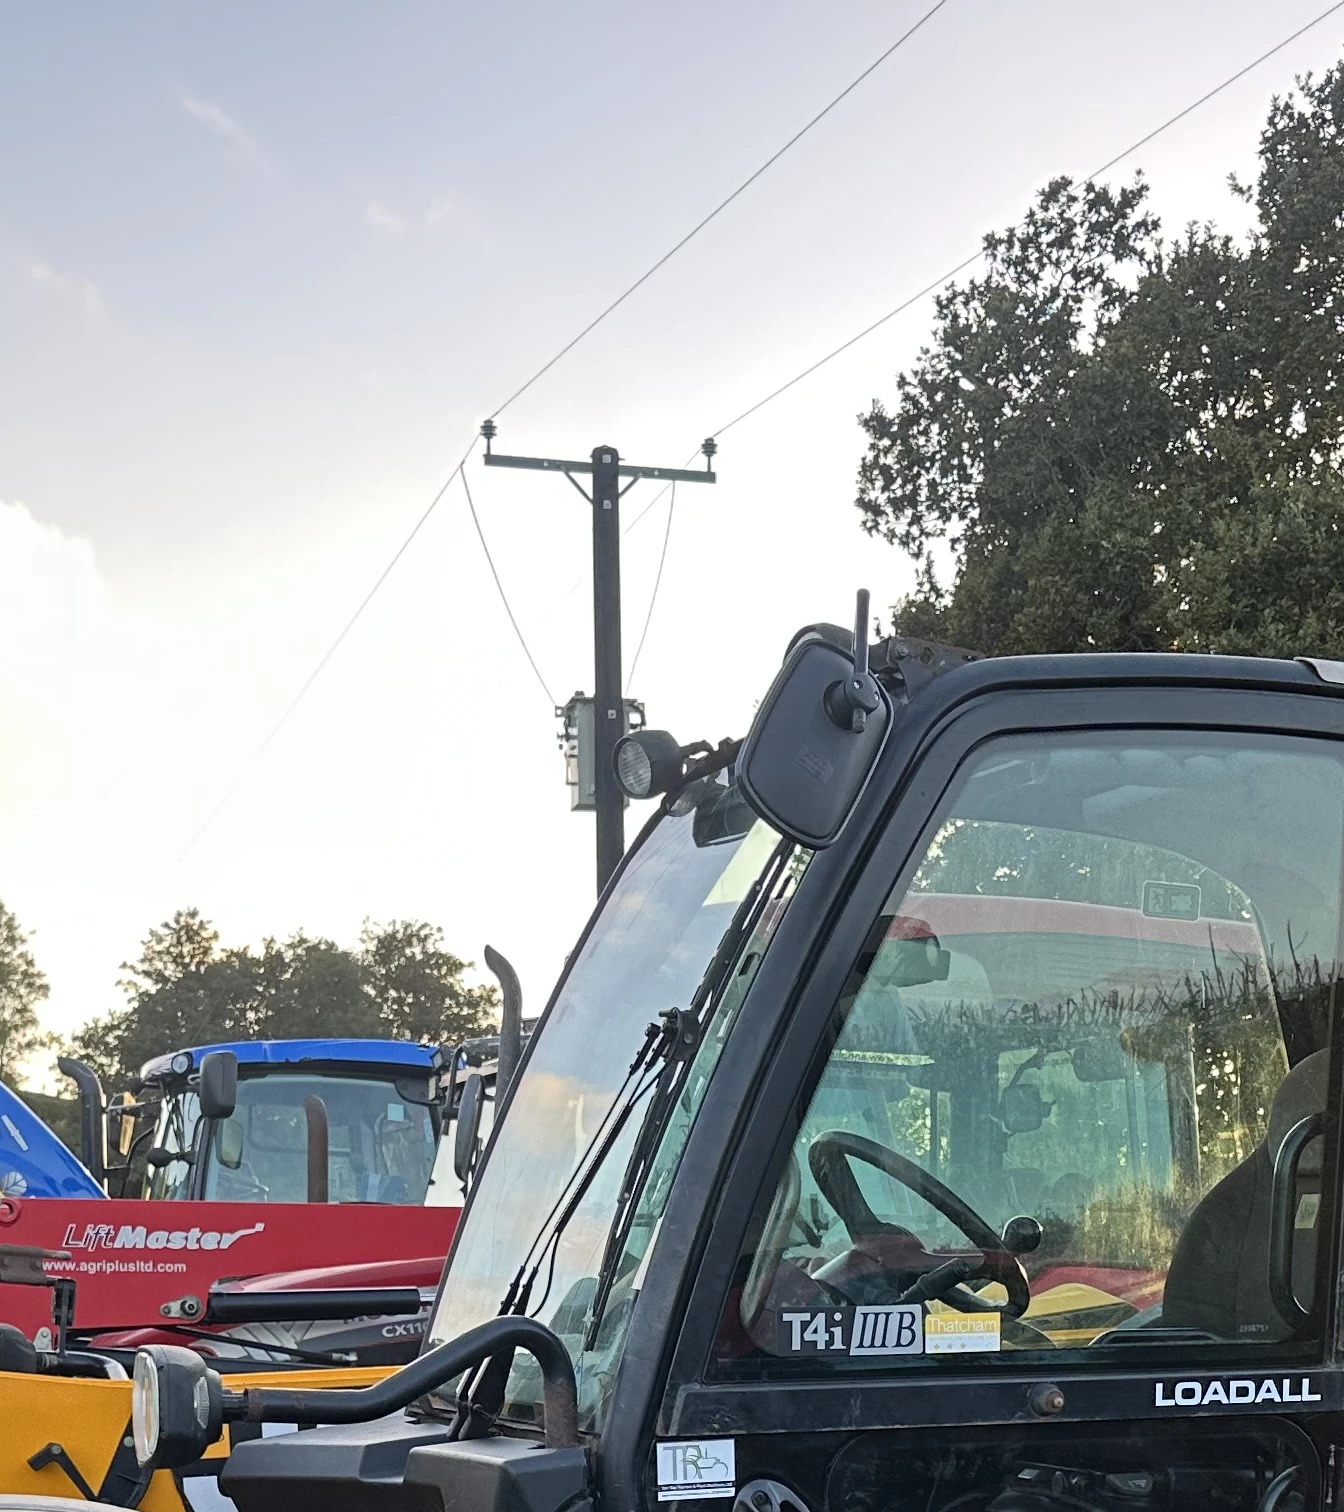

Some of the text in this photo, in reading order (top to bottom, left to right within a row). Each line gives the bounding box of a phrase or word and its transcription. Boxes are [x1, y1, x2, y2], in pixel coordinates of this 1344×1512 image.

[62, 1222, 265, 1251] LiftMaster
[42, 1260, 187, 1275] www.agriplusltd.com
[782, 1310, 917, 1351] T4i IIIB
[927, 1317, 998, 1333] Thatcham
[1155, 1378, 1322, 1407] LOADALL
